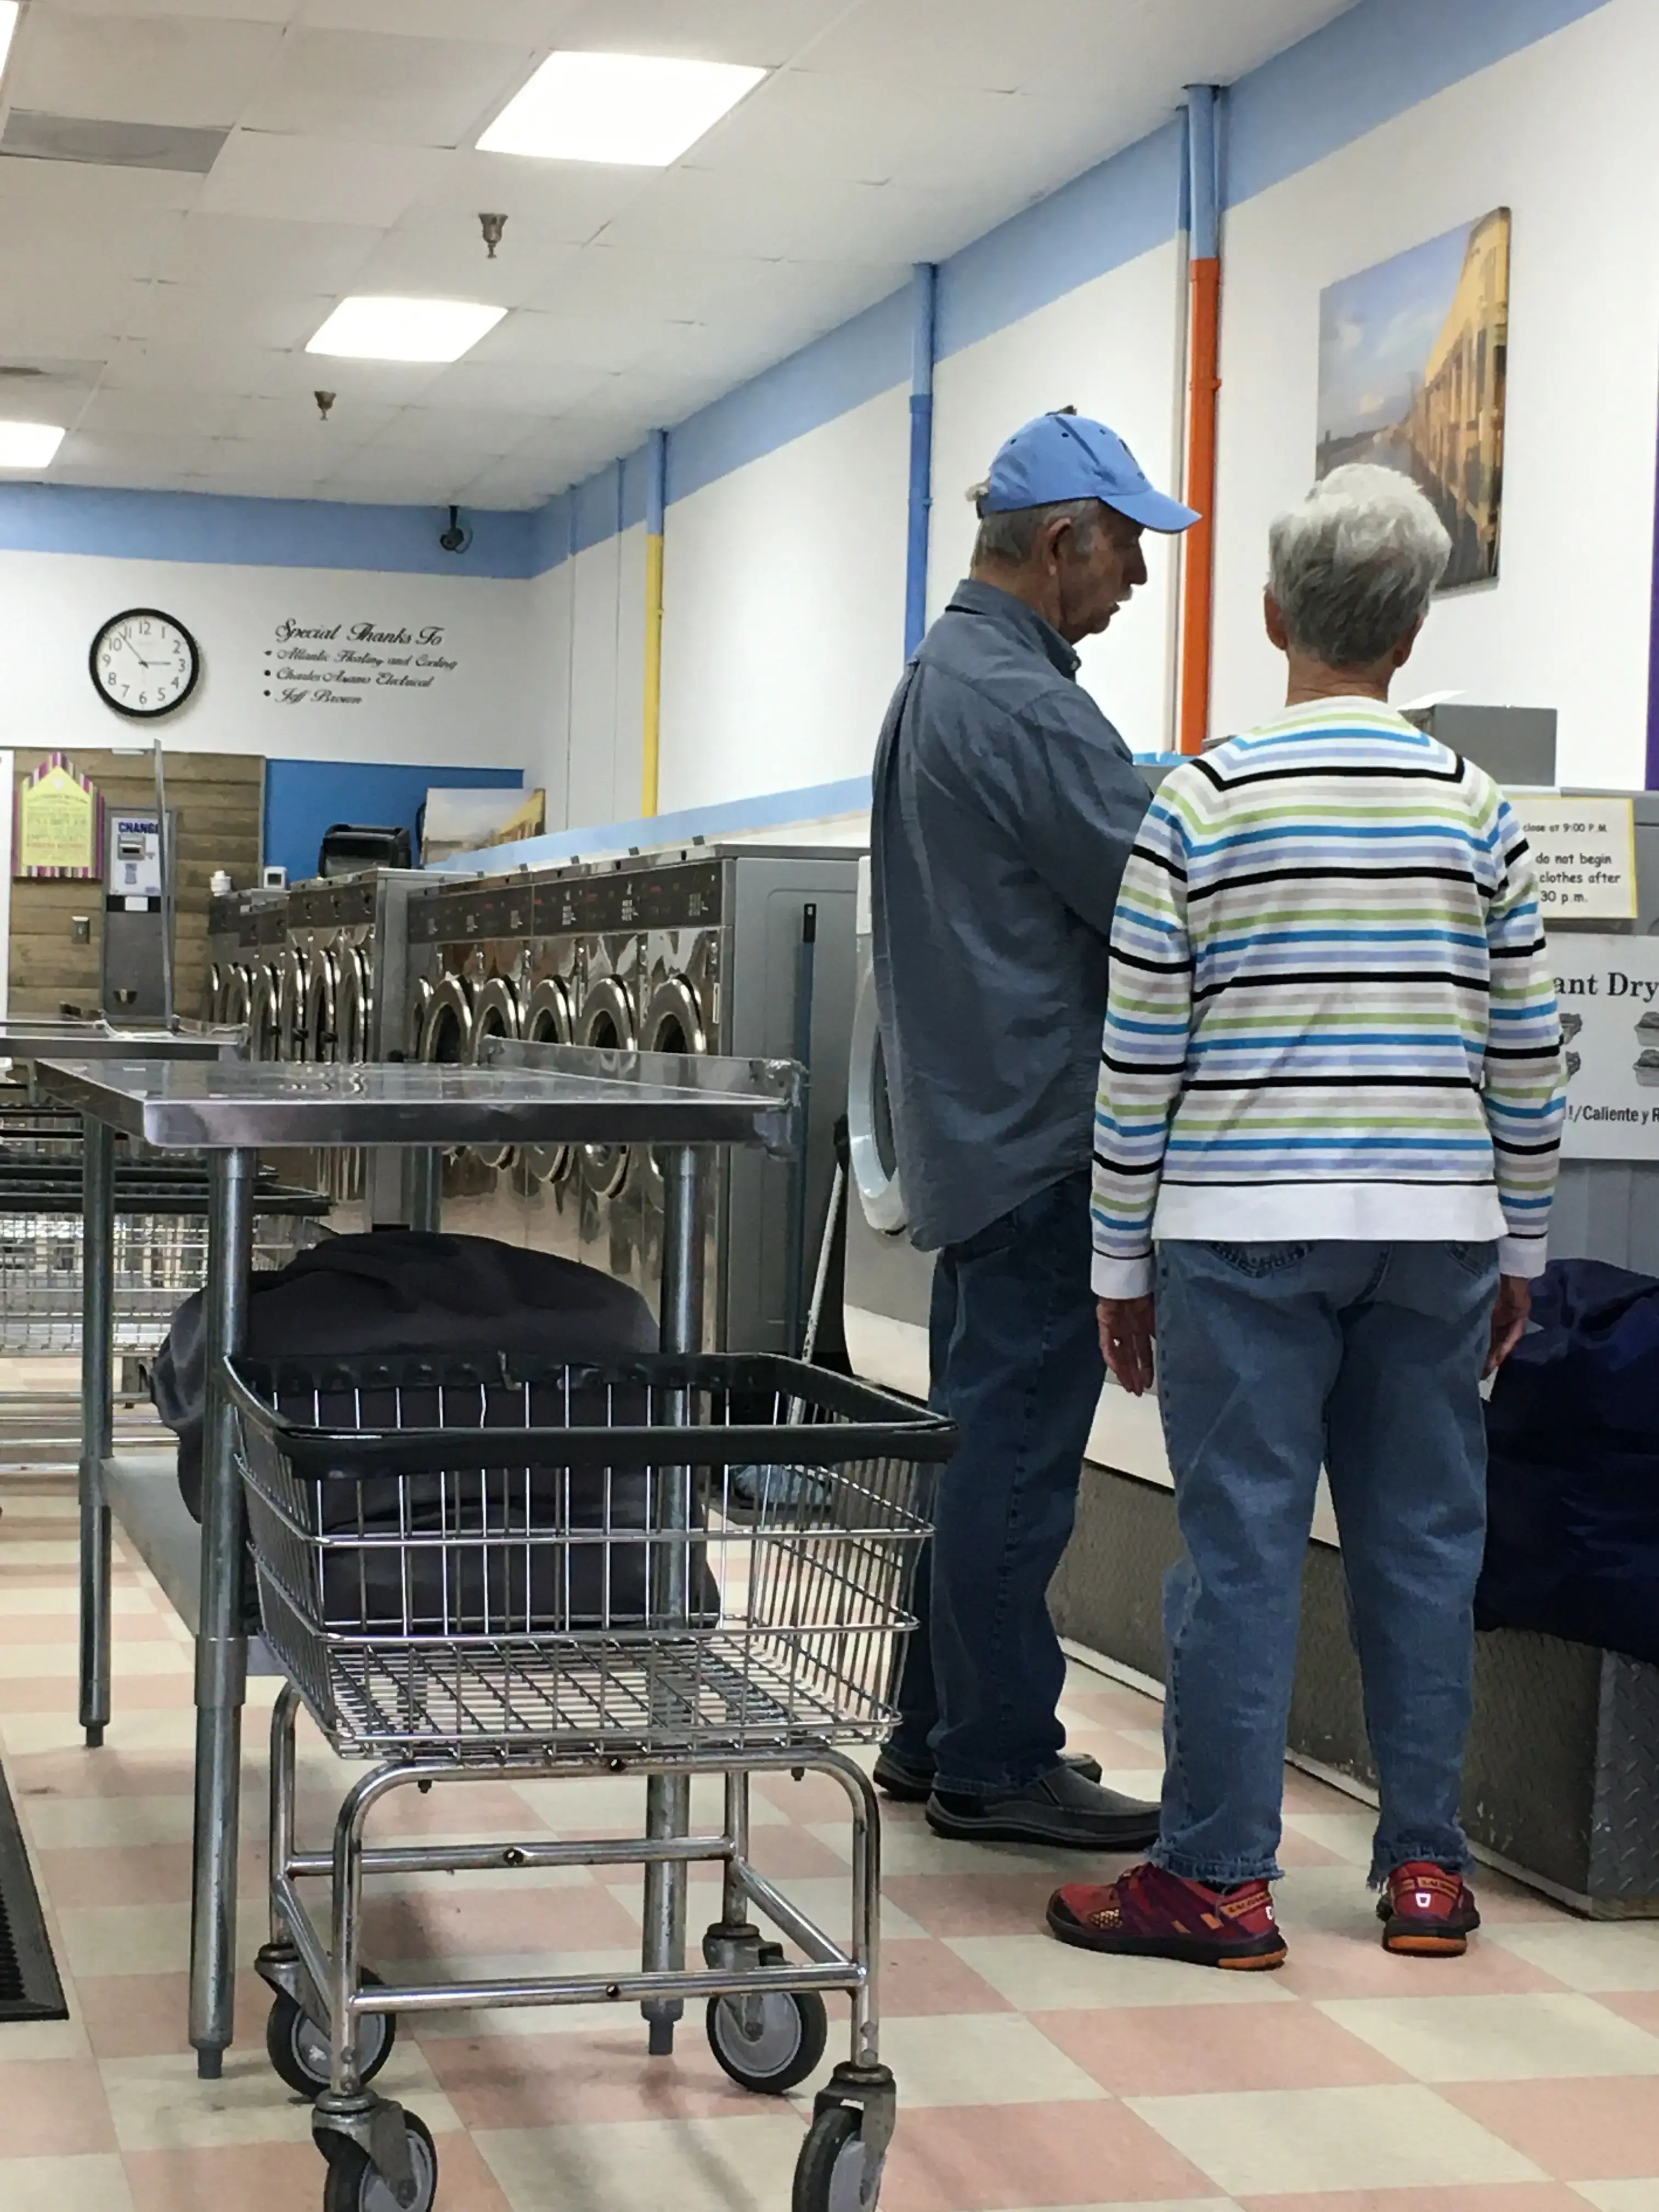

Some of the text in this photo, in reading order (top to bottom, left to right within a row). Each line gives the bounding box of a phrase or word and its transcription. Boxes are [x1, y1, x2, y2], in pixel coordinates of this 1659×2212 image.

[124, 625, 132, 639] 11
[139, 618, 151, 635] 12
[161, 625, 166, 639] 1
[275, 617, 445, 645] Special Thanks To
[109, 637, 122, 652] 10
[172, 639, 181, 654] 2
[102, 654, 111, 668] 9
[178, 658, 186, 673] 3
[108, 672, 117, 686] 8
[170, 676, 179, 690] 4
[121, 684, 131, 697] 7
[157, 687, 166, 701] 5
[138, 691, 148, 705] 6
[1563, 823, 1585, 833] 9:00
[1536, 853, 1612, 868] do not begin
[1539, 871, 1621, 884] clothes after
[1641, 1110, 1650, 1126] y
